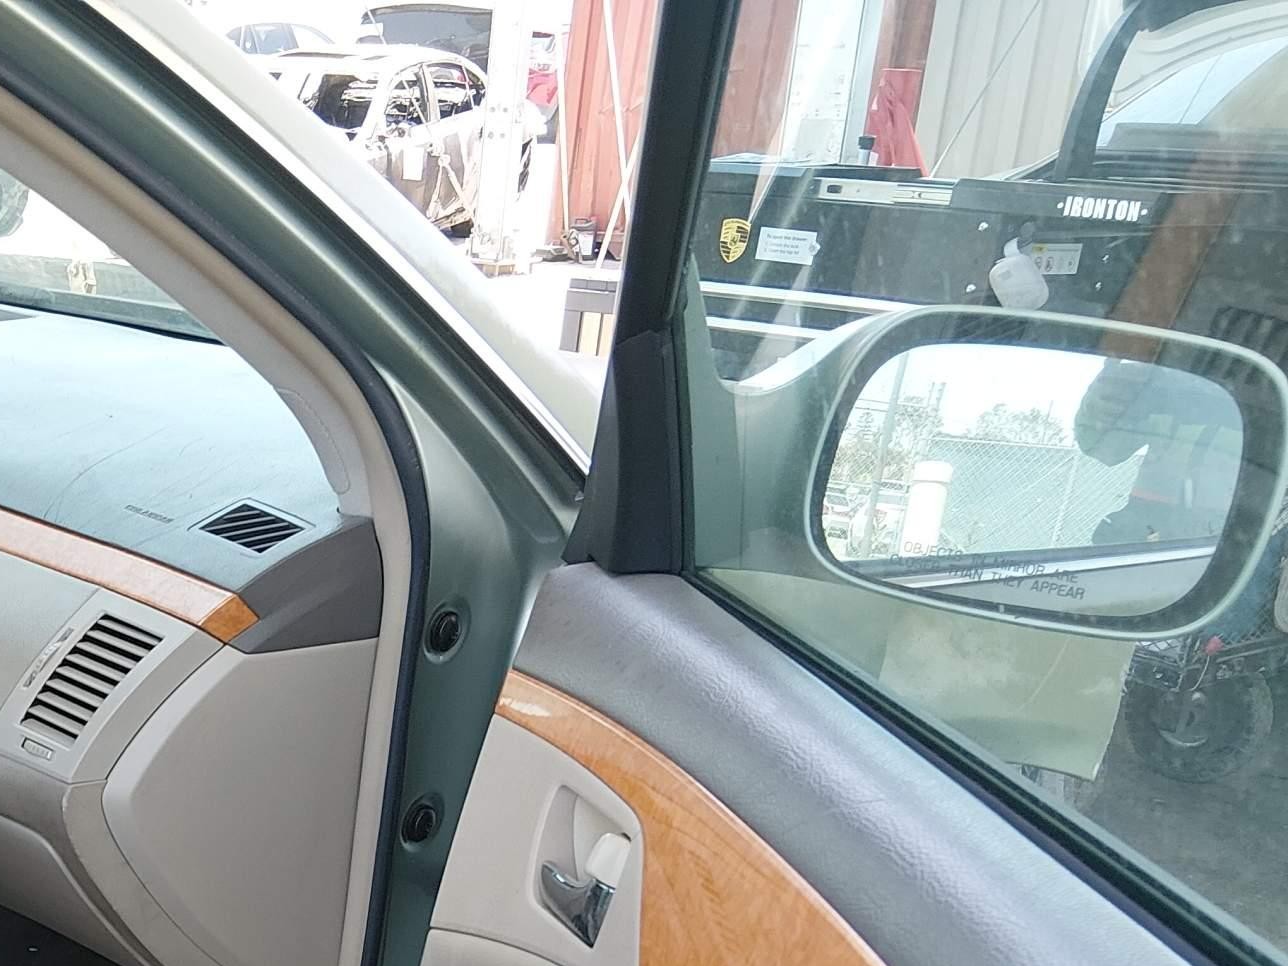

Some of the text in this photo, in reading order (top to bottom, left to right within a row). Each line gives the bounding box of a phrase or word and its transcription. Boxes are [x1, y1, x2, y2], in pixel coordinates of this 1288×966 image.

[1062, 195, 1142, 222] IRONTON
[903, 541, 963, 561] OBJECTS
[1029, 581, 1087, 601] APPEAR
